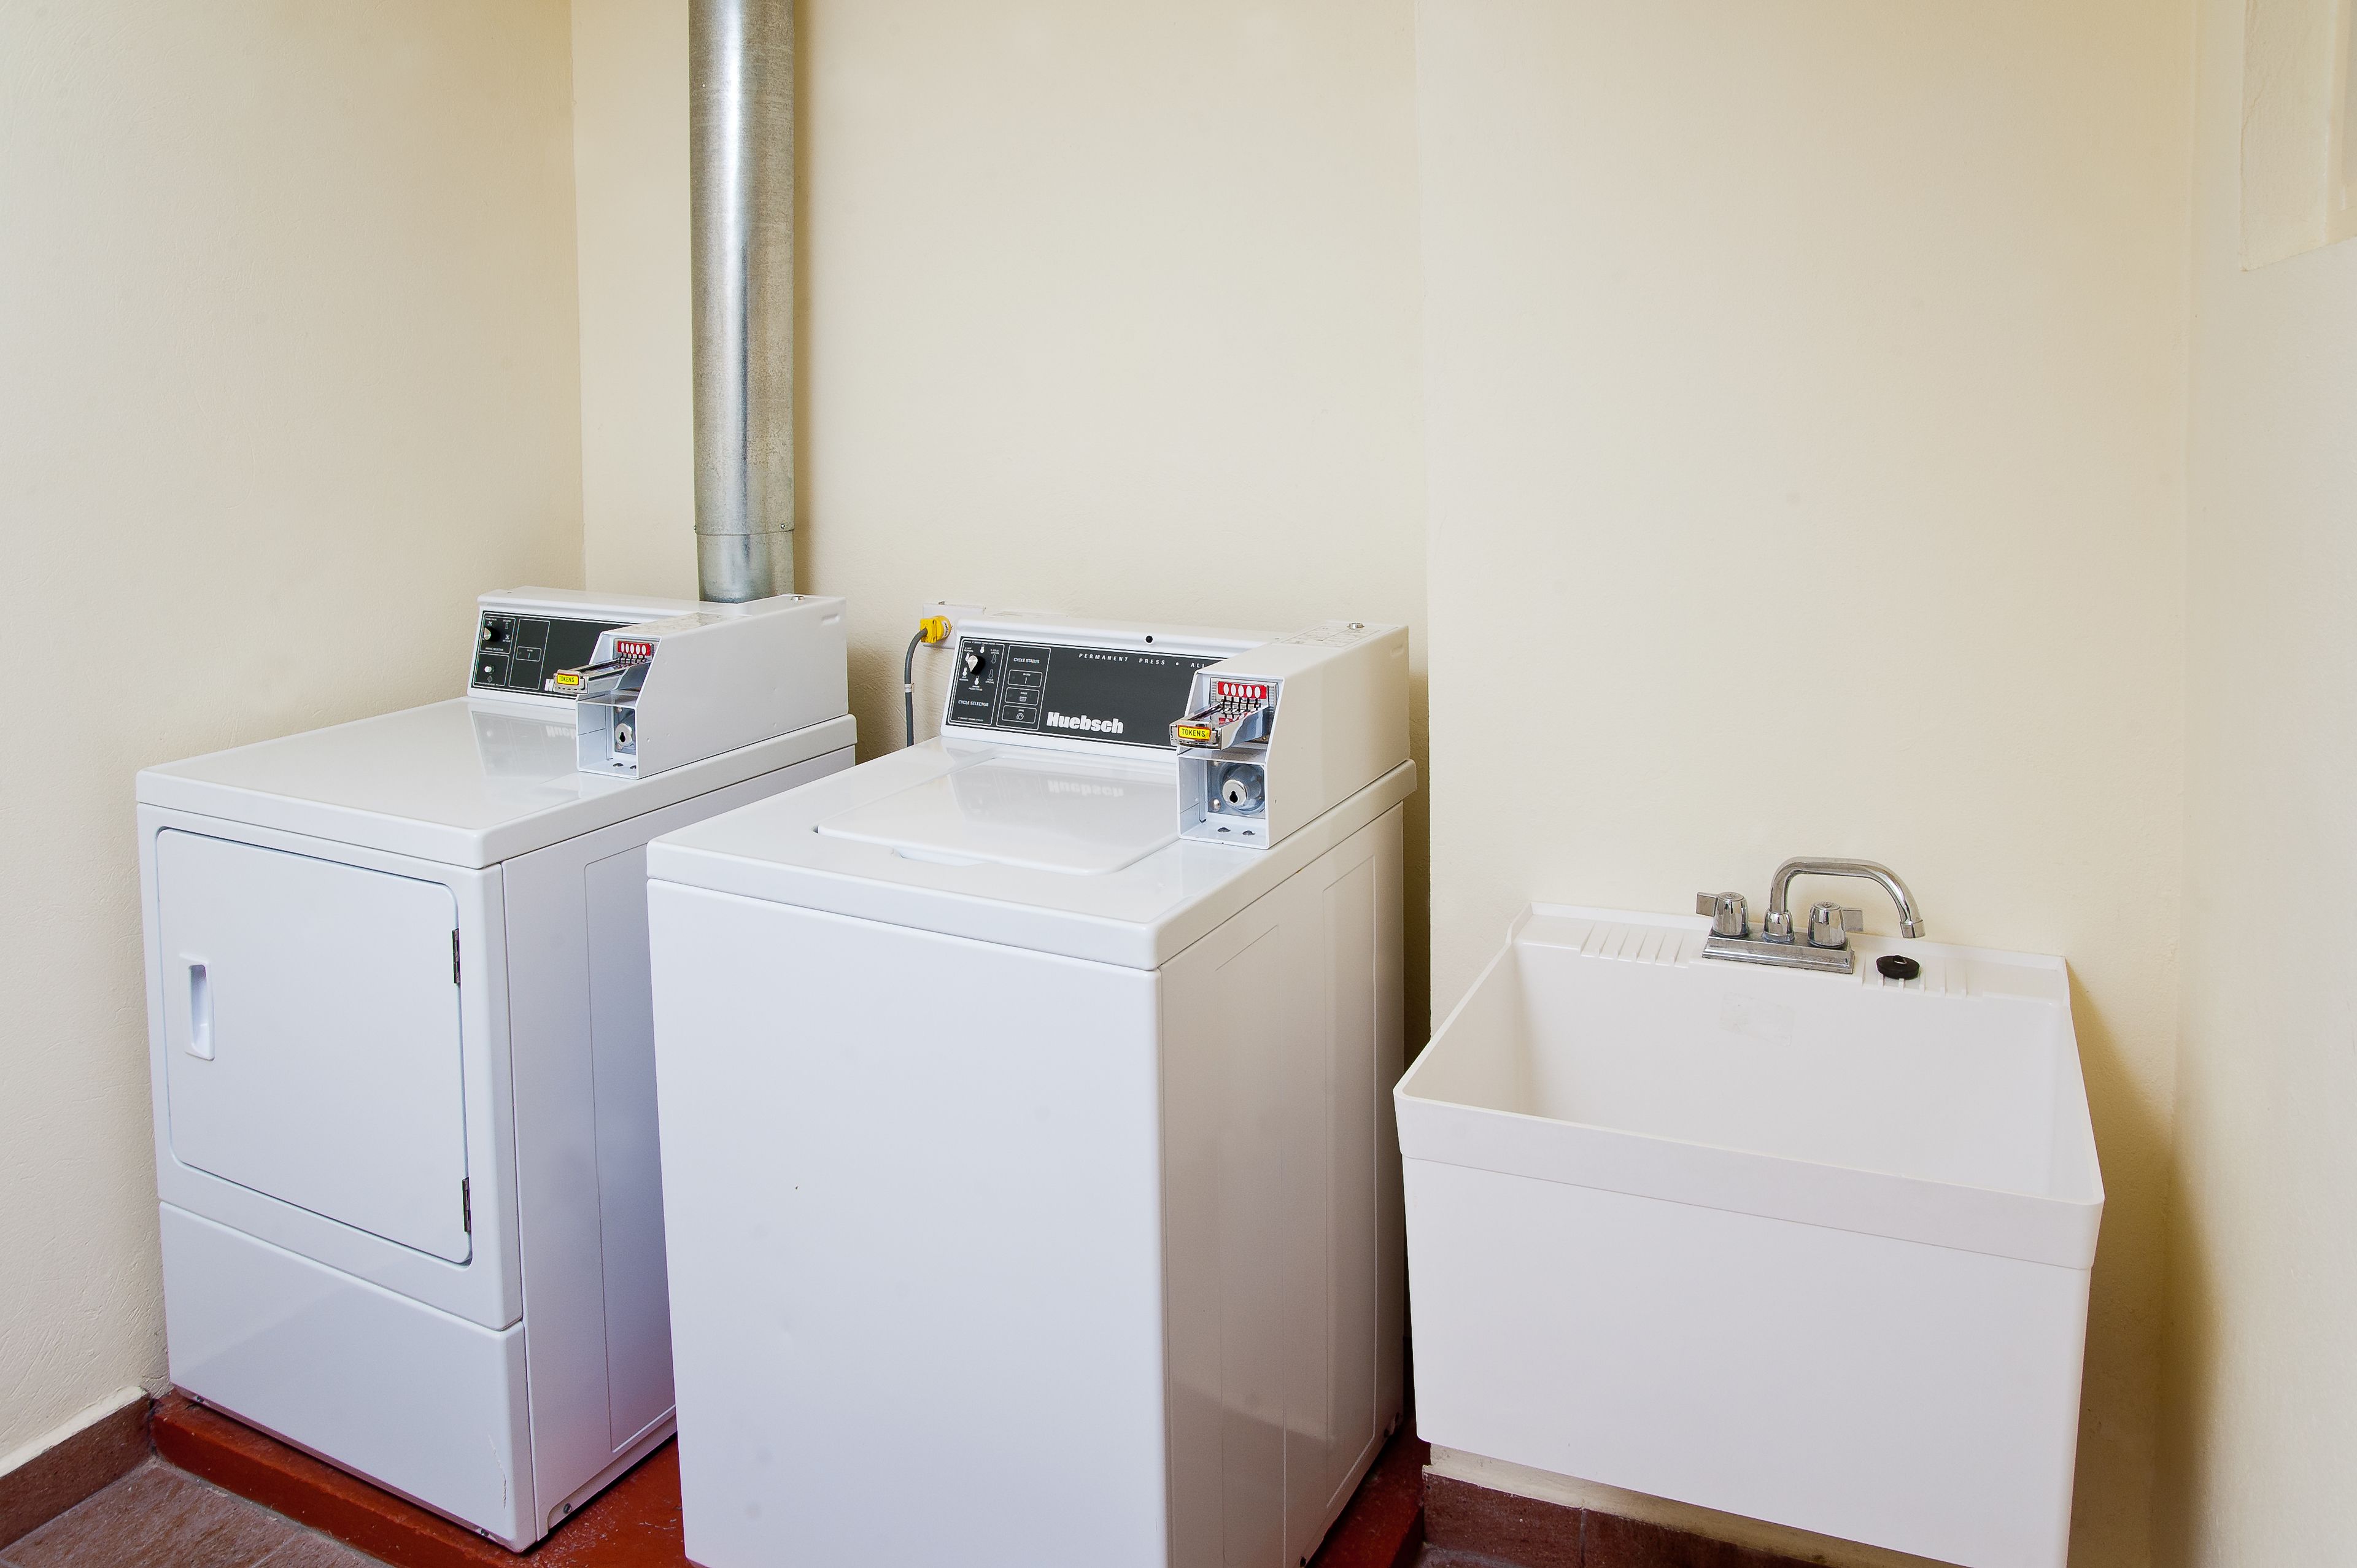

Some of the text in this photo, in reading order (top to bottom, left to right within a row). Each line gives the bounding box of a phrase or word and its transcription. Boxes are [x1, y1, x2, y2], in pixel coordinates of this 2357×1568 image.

[1078, 652, 1129, 663] PERMANENT
[1047, 711, 1124, 735] Huebsch
[1182, 728, 1206, 737] TOKENS
